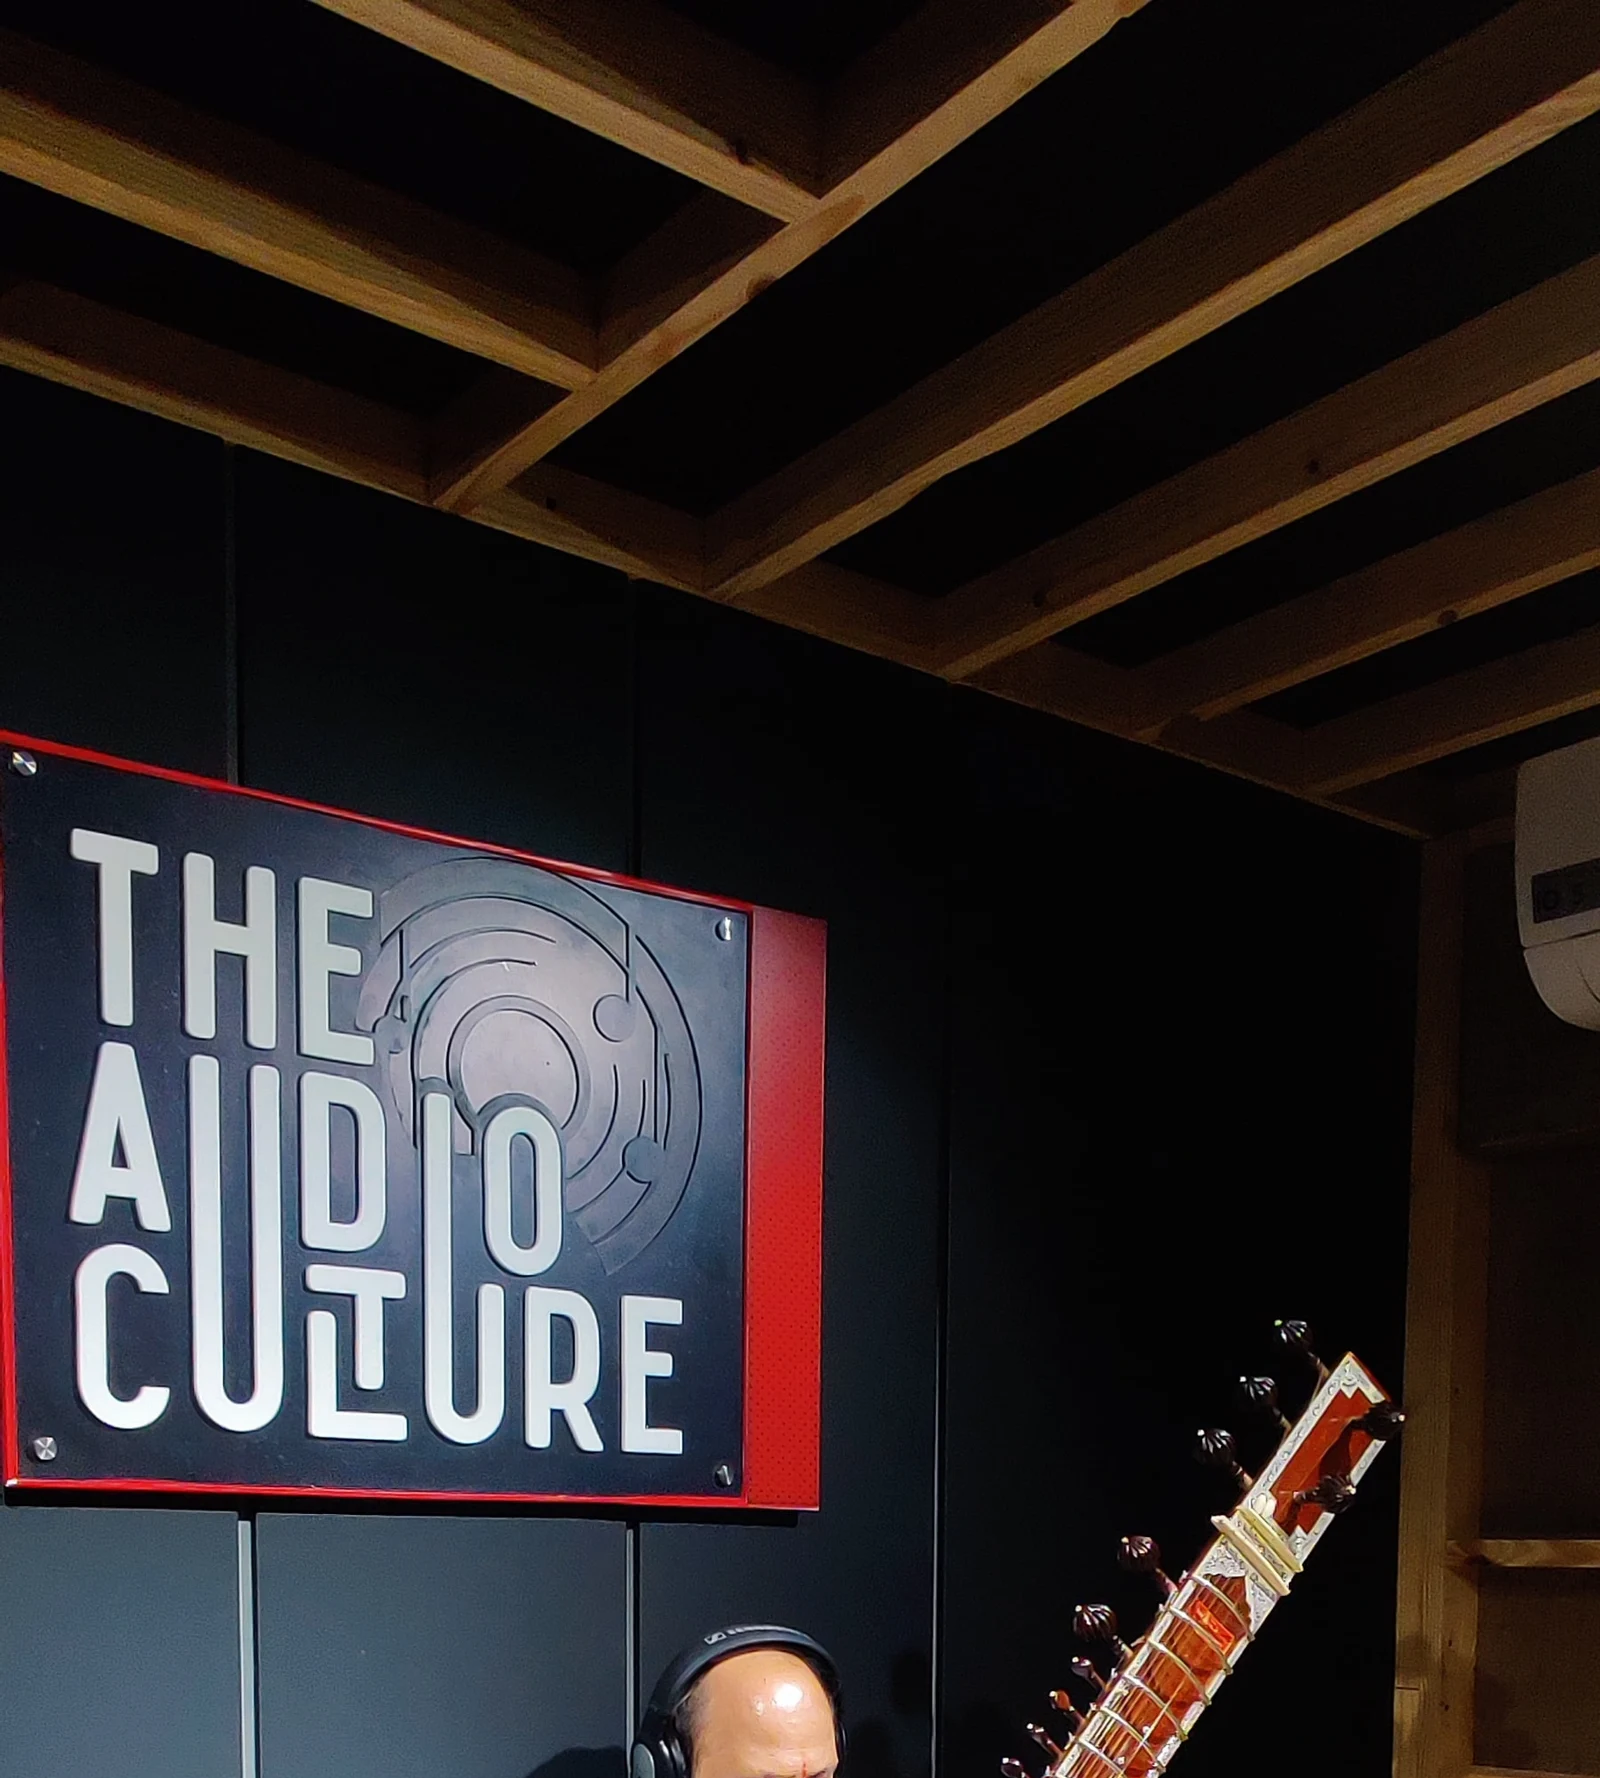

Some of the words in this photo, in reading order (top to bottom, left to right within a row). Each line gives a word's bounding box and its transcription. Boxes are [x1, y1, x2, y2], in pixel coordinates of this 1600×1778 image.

[70, 828, 376, 1066] THE
[69, 1041, 563, 1277] AUDIO
[75, 1243, 684, 1455] CULTURE
